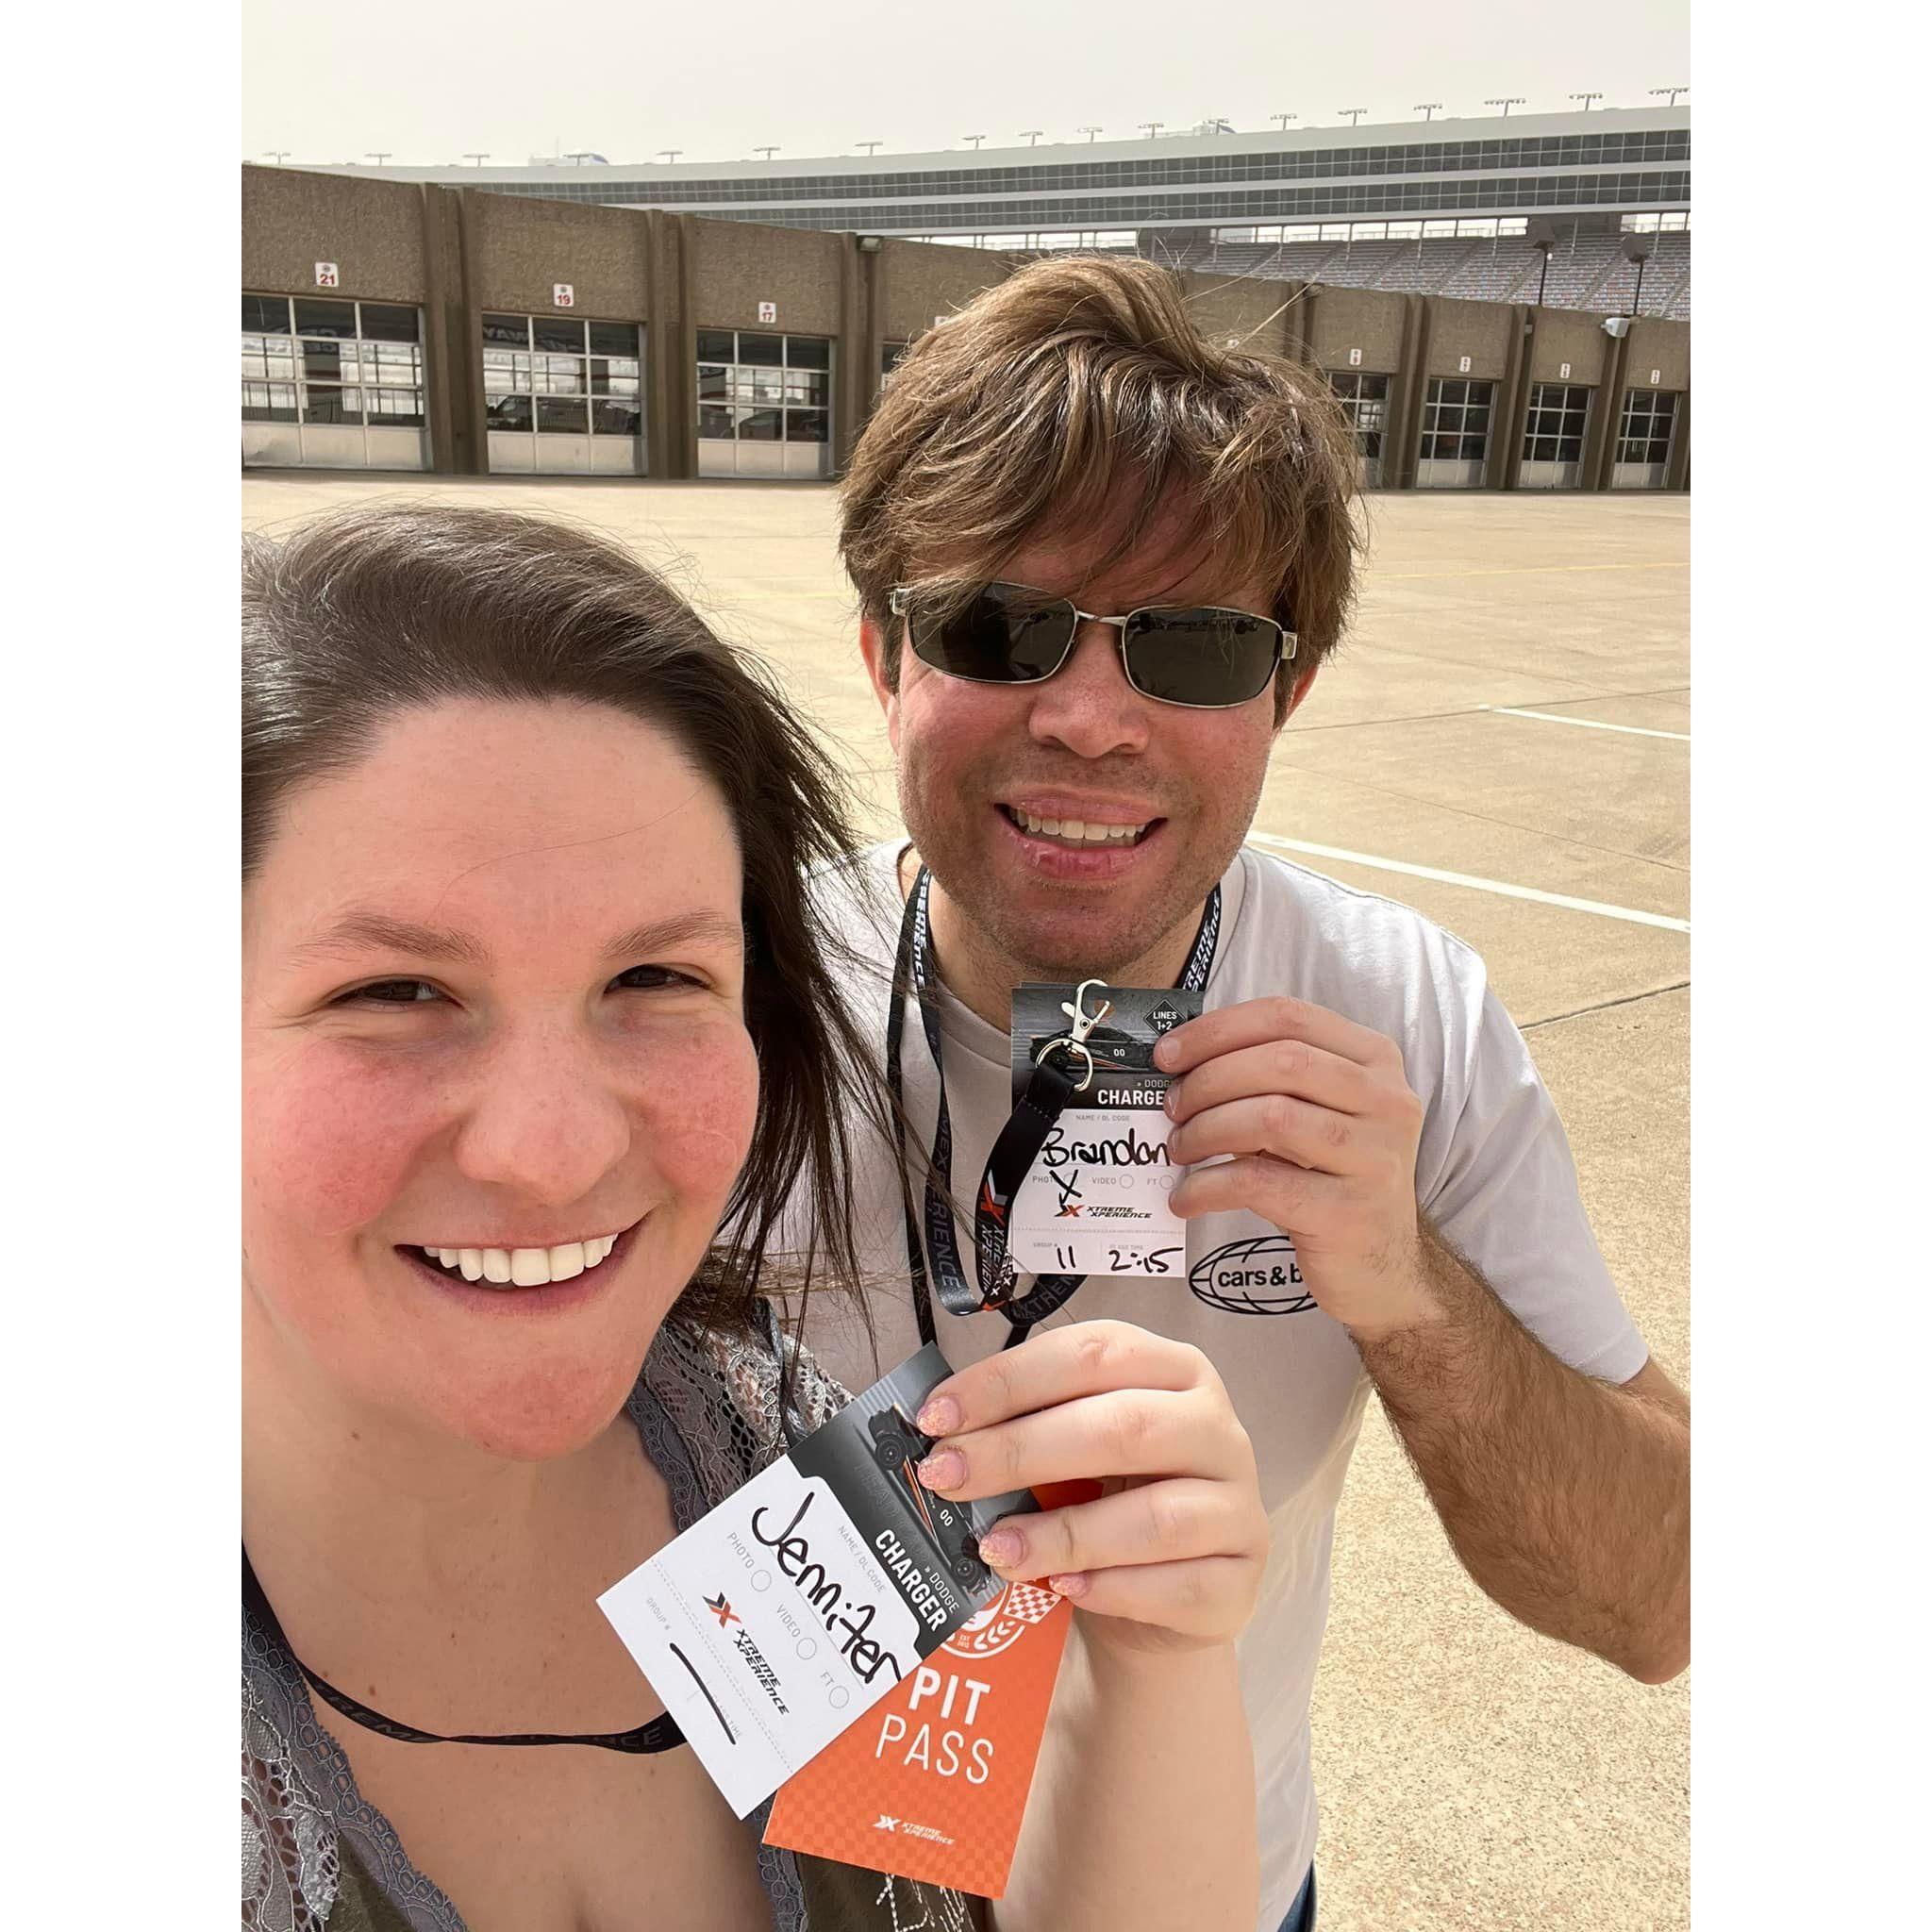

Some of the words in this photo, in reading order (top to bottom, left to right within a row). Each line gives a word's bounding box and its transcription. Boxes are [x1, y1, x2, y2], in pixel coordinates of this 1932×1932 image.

[320, 274, 335, 285] 21
[558, 294, 571, 305] 19
[762, 312, 774, 322] 17
[1153, 1011, 1177, 1020] LINES
[1144, 1079, 1171, 1088] DODG
[1097, 1090, 1165, 1106] CHARGE
[1041, 1127, 1171, 1167] Brandon
[1032, 1175, 1058, 1184] PHOT
[1058, 1245, 1076, 1270] 11
[1108, 1247, 1184, 1273] 2:15
[939, 1509, 954, 1526] 00
[838, 1525, 858, 1552] NAME
[858, 1557, 870, 1570] DL
[866, 1569, 887, 1592] CODE
[752, 1491, 902, 1684] Jennifer
[875, 1529, 948, 1632] CHARGER
[930, 1572, 960, 1614] DODGE
[645, 1597, 666, 1624] GROUP
[726, 1532, 755, 1569] PHOTO
[776, 1605, 801, 1638] VIDEO
[820, 1671, 835, 1686] FT
[736, 1629, 782, 1687] XTREME
[732, 1636, 791, 1716] XPERIENCE
[908, 1665, 991, 1725] PIT
[874, 1712, 994, 1785] PASS
